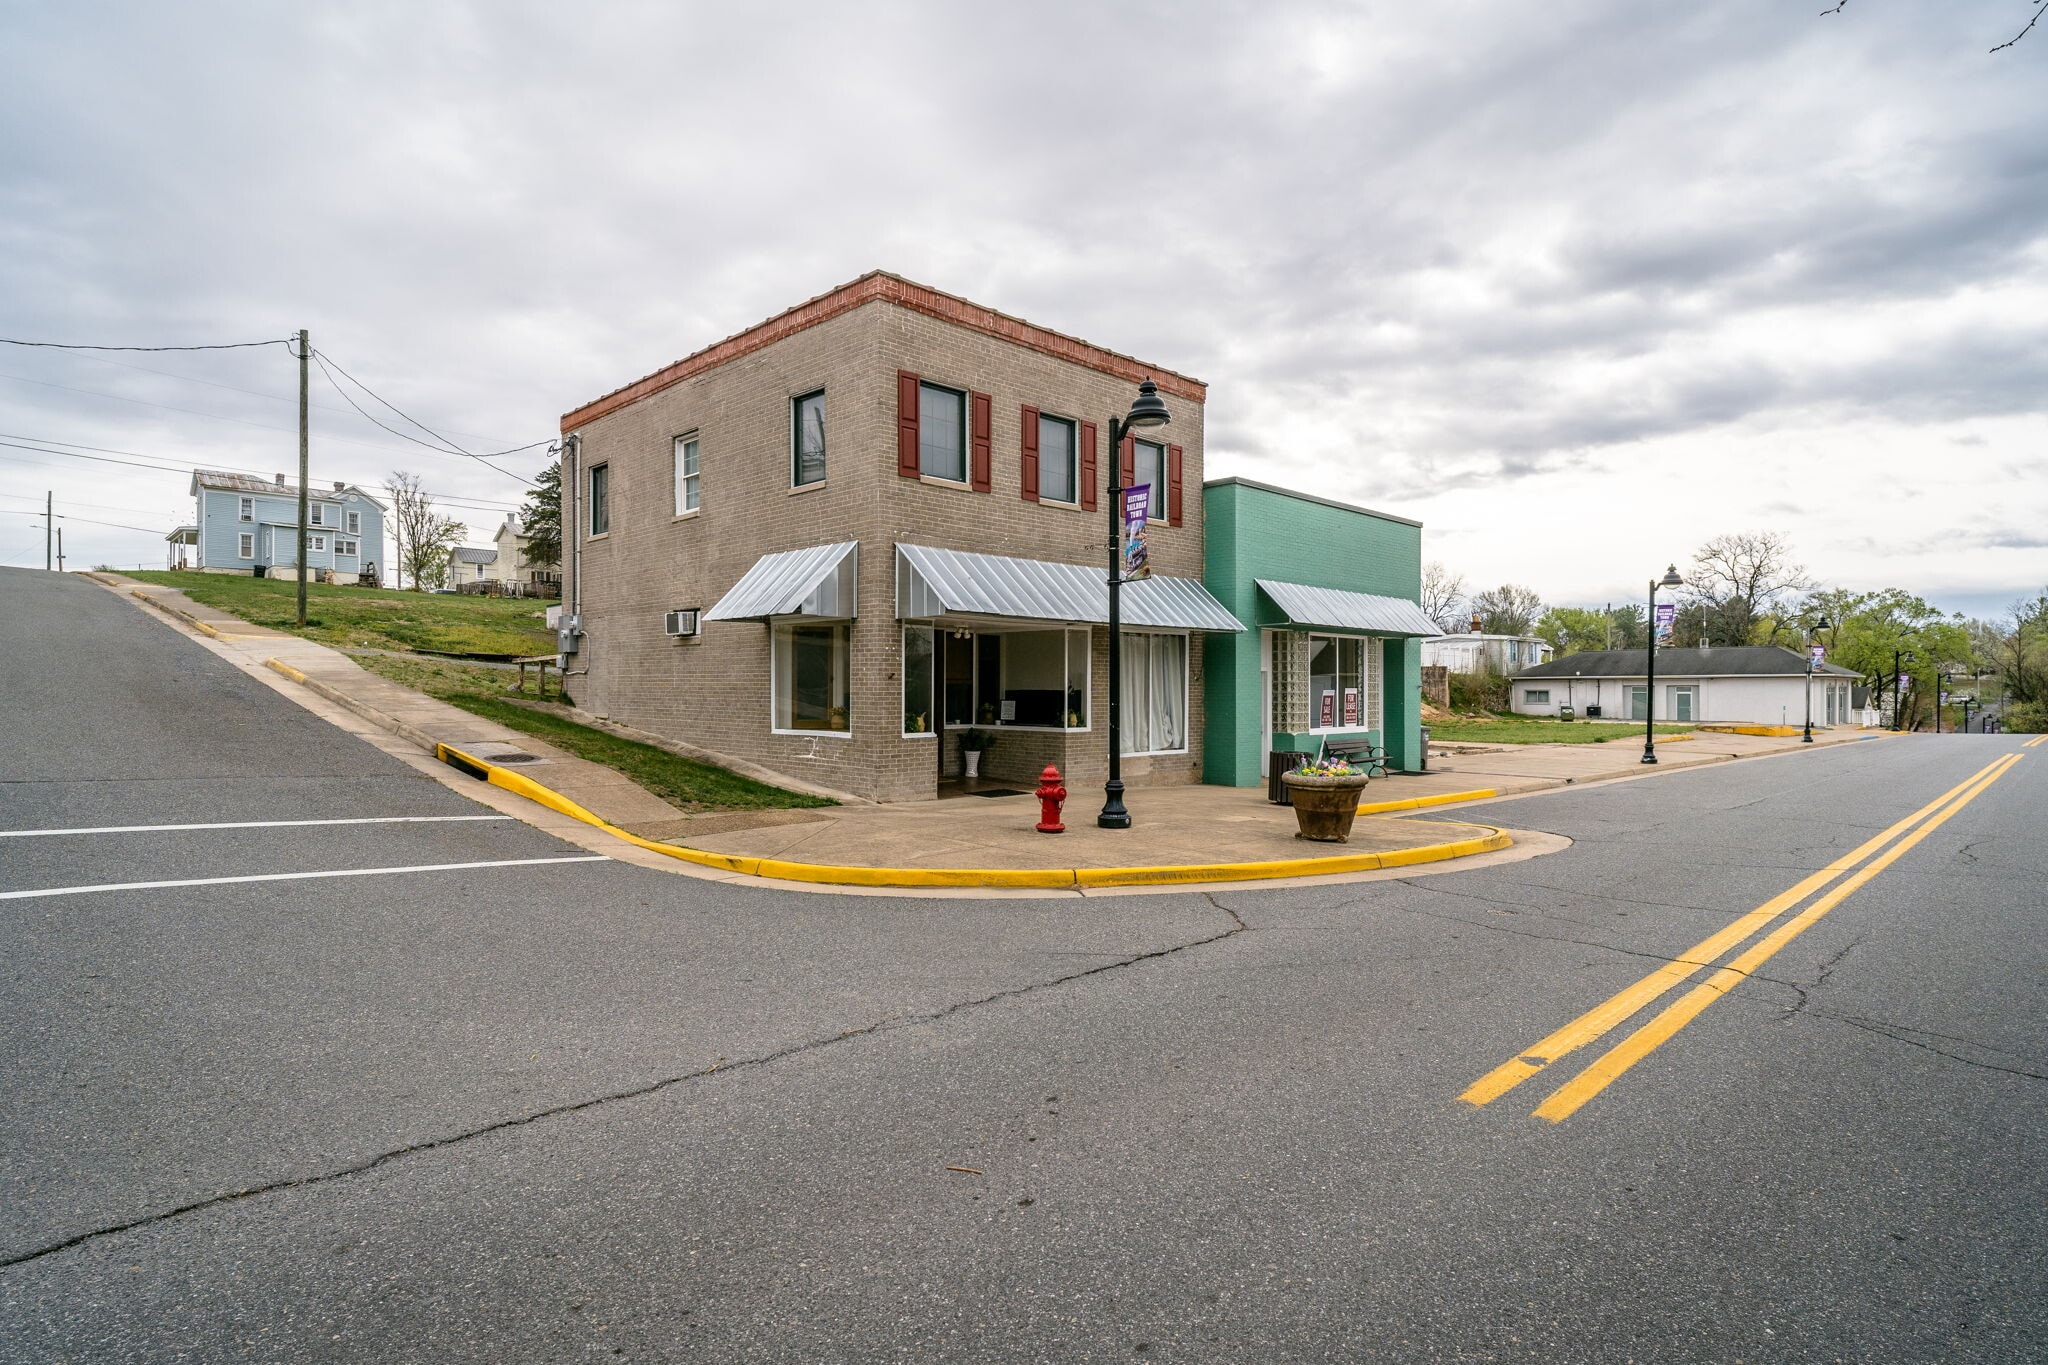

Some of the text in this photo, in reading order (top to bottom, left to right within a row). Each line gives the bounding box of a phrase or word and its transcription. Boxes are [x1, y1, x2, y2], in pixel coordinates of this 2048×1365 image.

[1128, 493, 1147, 503] HISTORIC
[1130, 510, 1142, 518] TOWN
[1323, 705, 1331, 714] SALE
